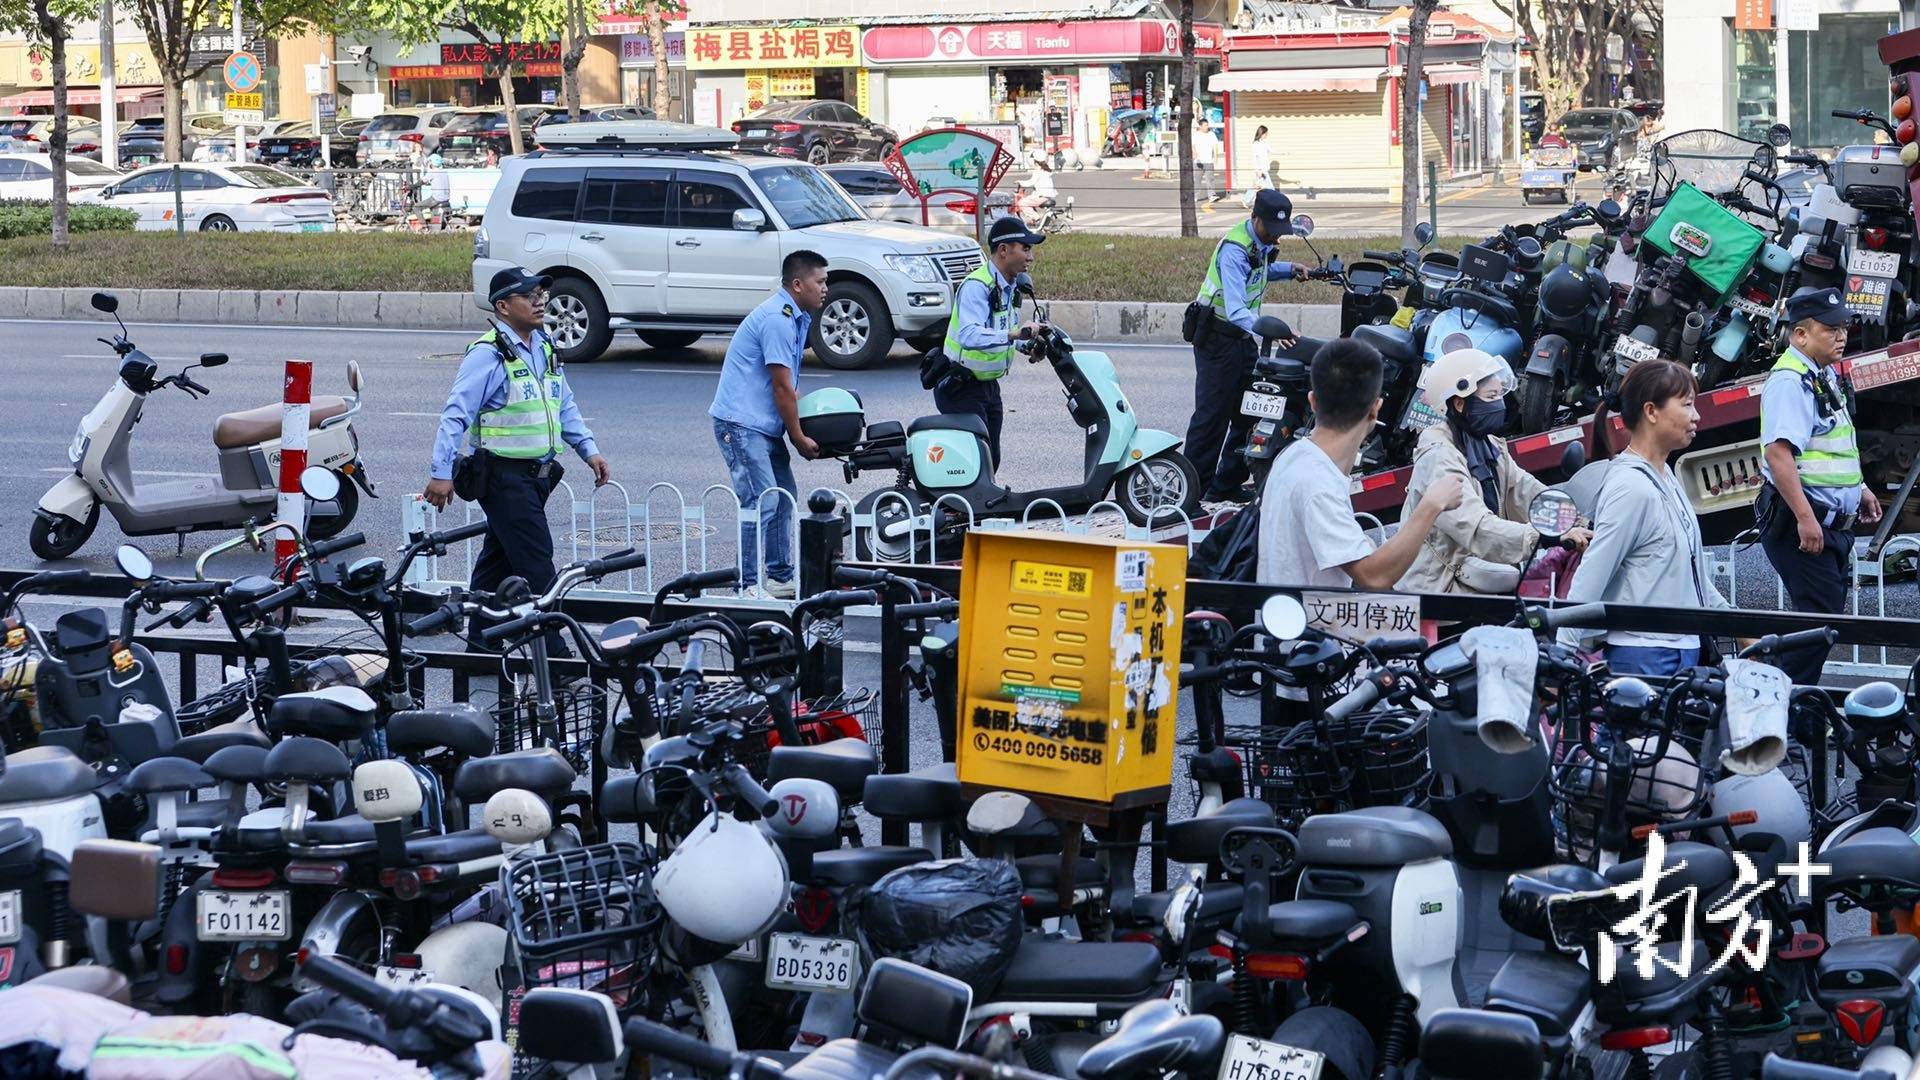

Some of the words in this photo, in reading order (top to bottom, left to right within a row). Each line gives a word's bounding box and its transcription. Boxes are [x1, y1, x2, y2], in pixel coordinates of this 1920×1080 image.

[692, 29, 855, 62] 梅县盐焗鸡
[986, 31, 1023, 50] 天福
[1034, 36, 1071, 49] Tianfu
[227, 94, 261, 107] 严管路段
[1853, 259, 1894, 273] LE1052
[1862, 280, 1887, 295] 雅迪
[1853, 357, 1914, 377] 中国专用汽车之
[1245, 400, 1281, 415] LG1677
[1307, 599, 1418, 633] 文明停放
[991, 737, 1022, 755] 400
[1025, 741, 1057, 760] 000
[1060, 745, 1103, 766] 5658
[207, 912, 281, 931] F01142
[775, 955, 849, 983] BD5336
